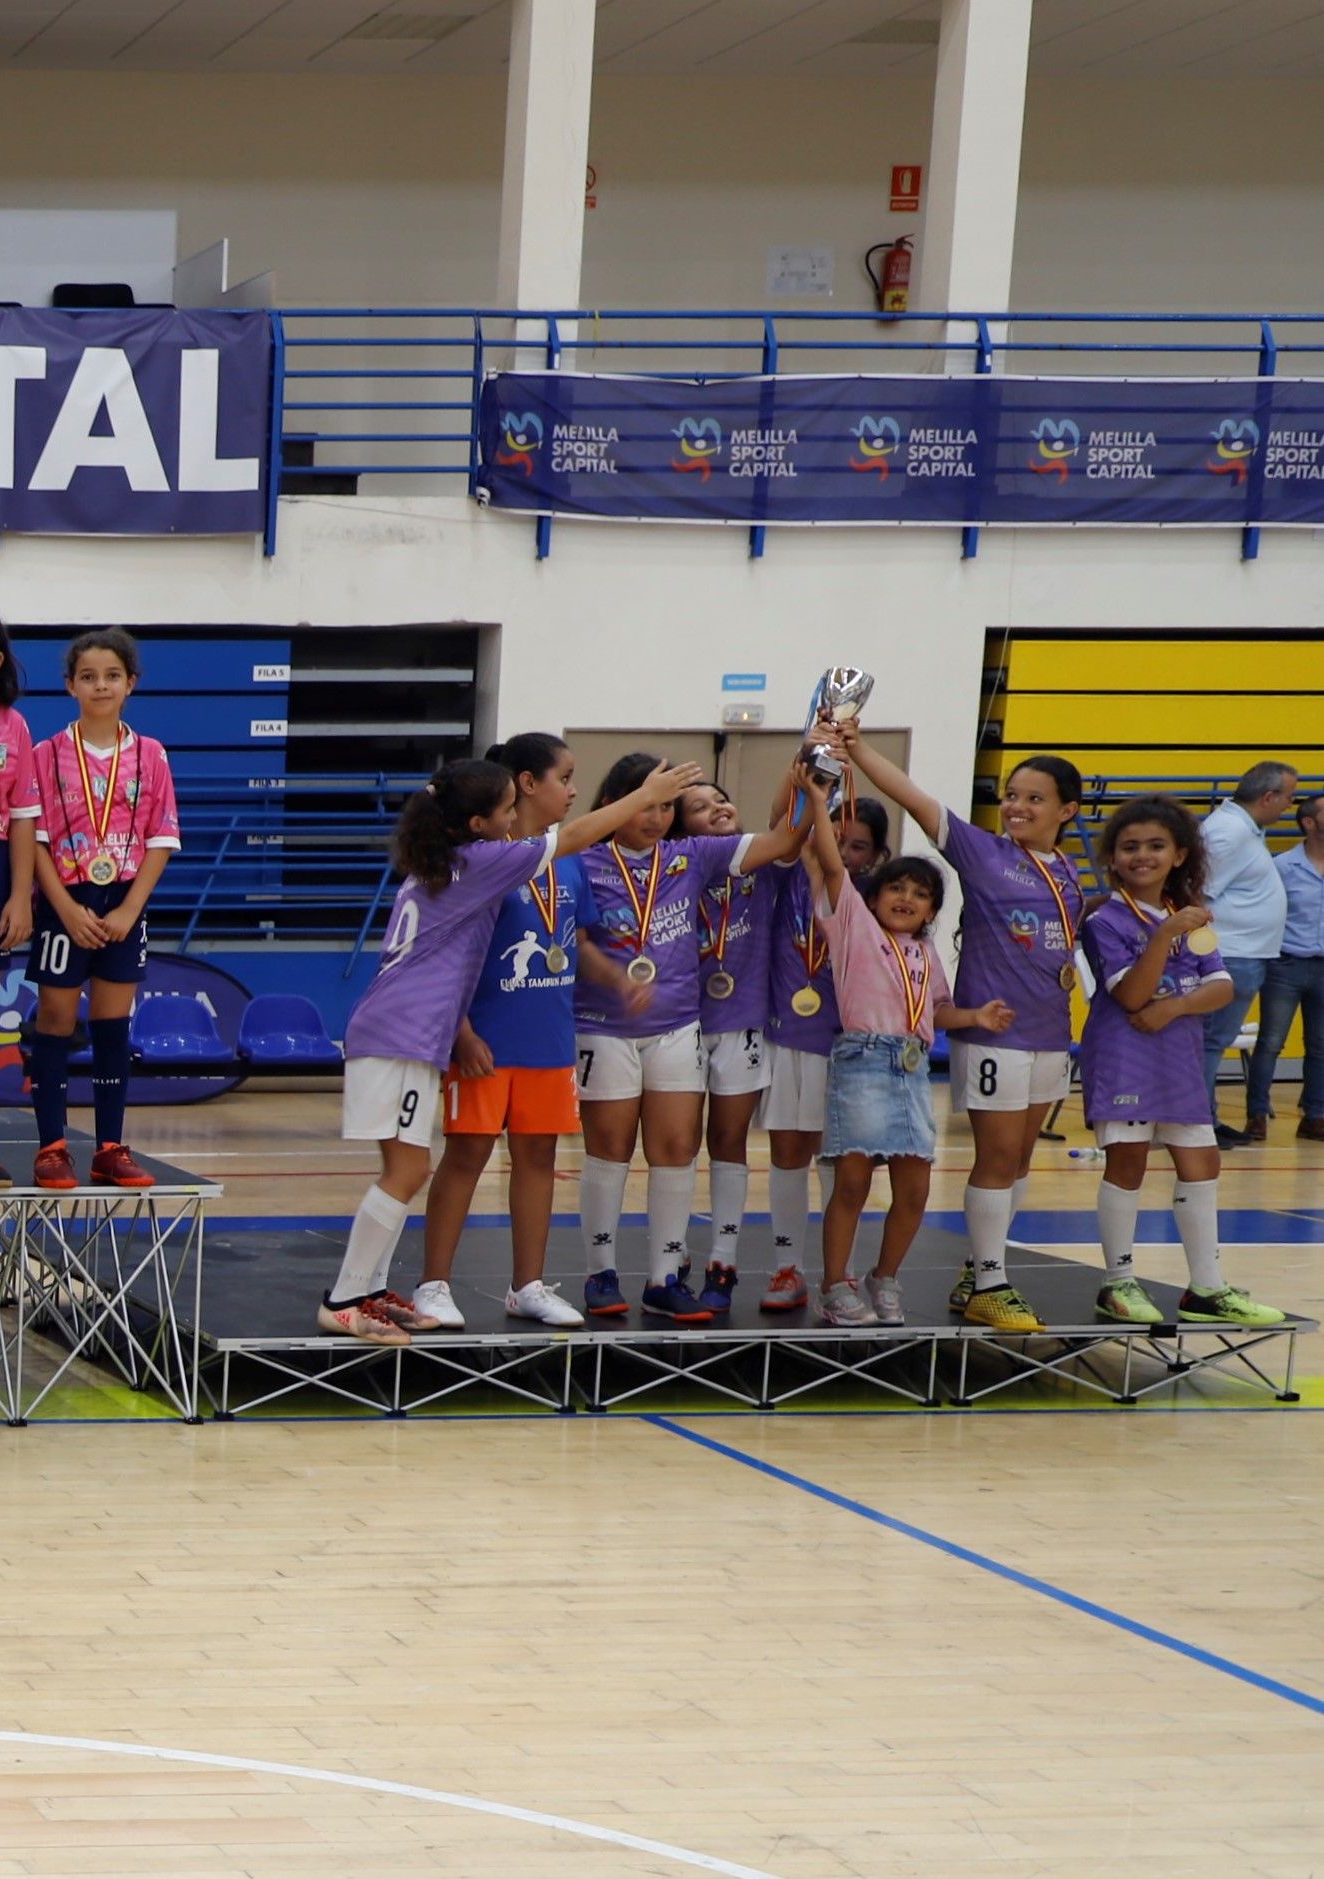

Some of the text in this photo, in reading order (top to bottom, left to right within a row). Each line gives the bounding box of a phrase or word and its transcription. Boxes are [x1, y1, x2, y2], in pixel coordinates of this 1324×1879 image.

[552, 424, 619, 443] MELILLA
[730, 428, 798, 445] MELILLA
[908, 429, 978, 444] MELILLA
[1088, 431, 1156, 447] MELILLA
[552, 441, 609, 457] SPORT
[730, 445, 786, 461] SPORT
[908, 445, 964, 461] SPORT
[1087, 447, 1143, 463] SPORT
[1265, 448, 1319, 463] SPORT
[551, 457, 618, 474] CAPITAL
[729, 462, 797, 477] CAPITAL
[907, 462, 975, 477] CAPITAL
[1086, 463, 1155, 479] CAPITAL
[258, 669, 284, 677] FILA 5
[255, 724, 282, 732] FILA 4
[650, 912, 687, 934] SPORT
[40, 930, 70, 975] 10
[579, 1050, 594, 1087] 7
[980, 1058, 997, 1096] 8
[398, 1089, 419, 1128] 9
[449, 1081, 459, 1121] 1
